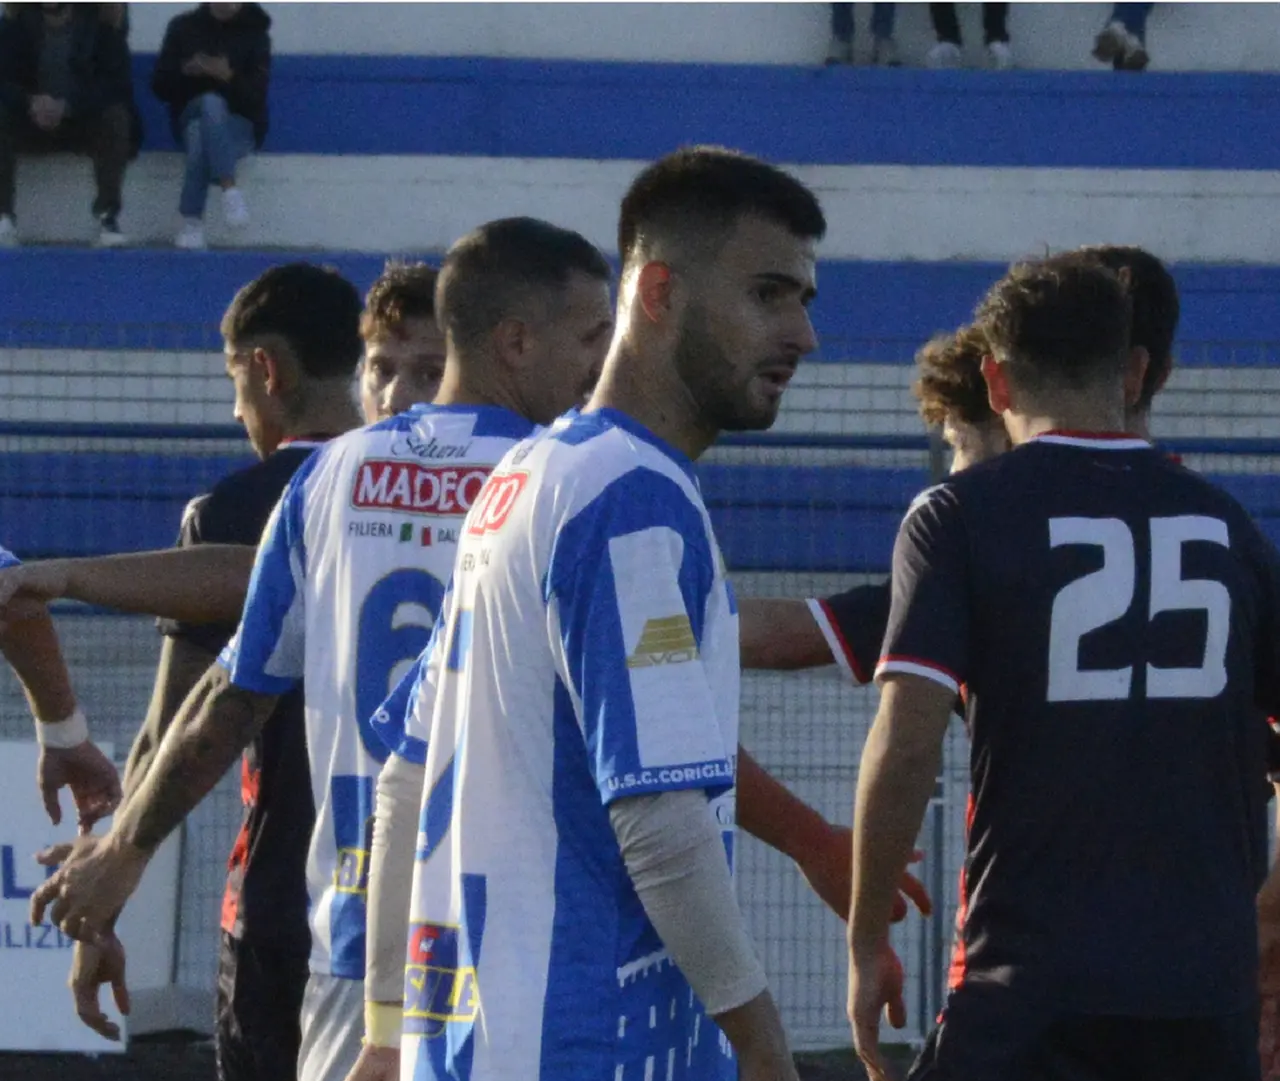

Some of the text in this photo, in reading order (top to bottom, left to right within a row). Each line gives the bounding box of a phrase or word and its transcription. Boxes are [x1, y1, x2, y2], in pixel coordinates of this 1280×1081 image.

[347, 521, 393, 537] FILIERA
[1046, 515, 1232, 702] 25
[356, 567, 446, 765] 6
